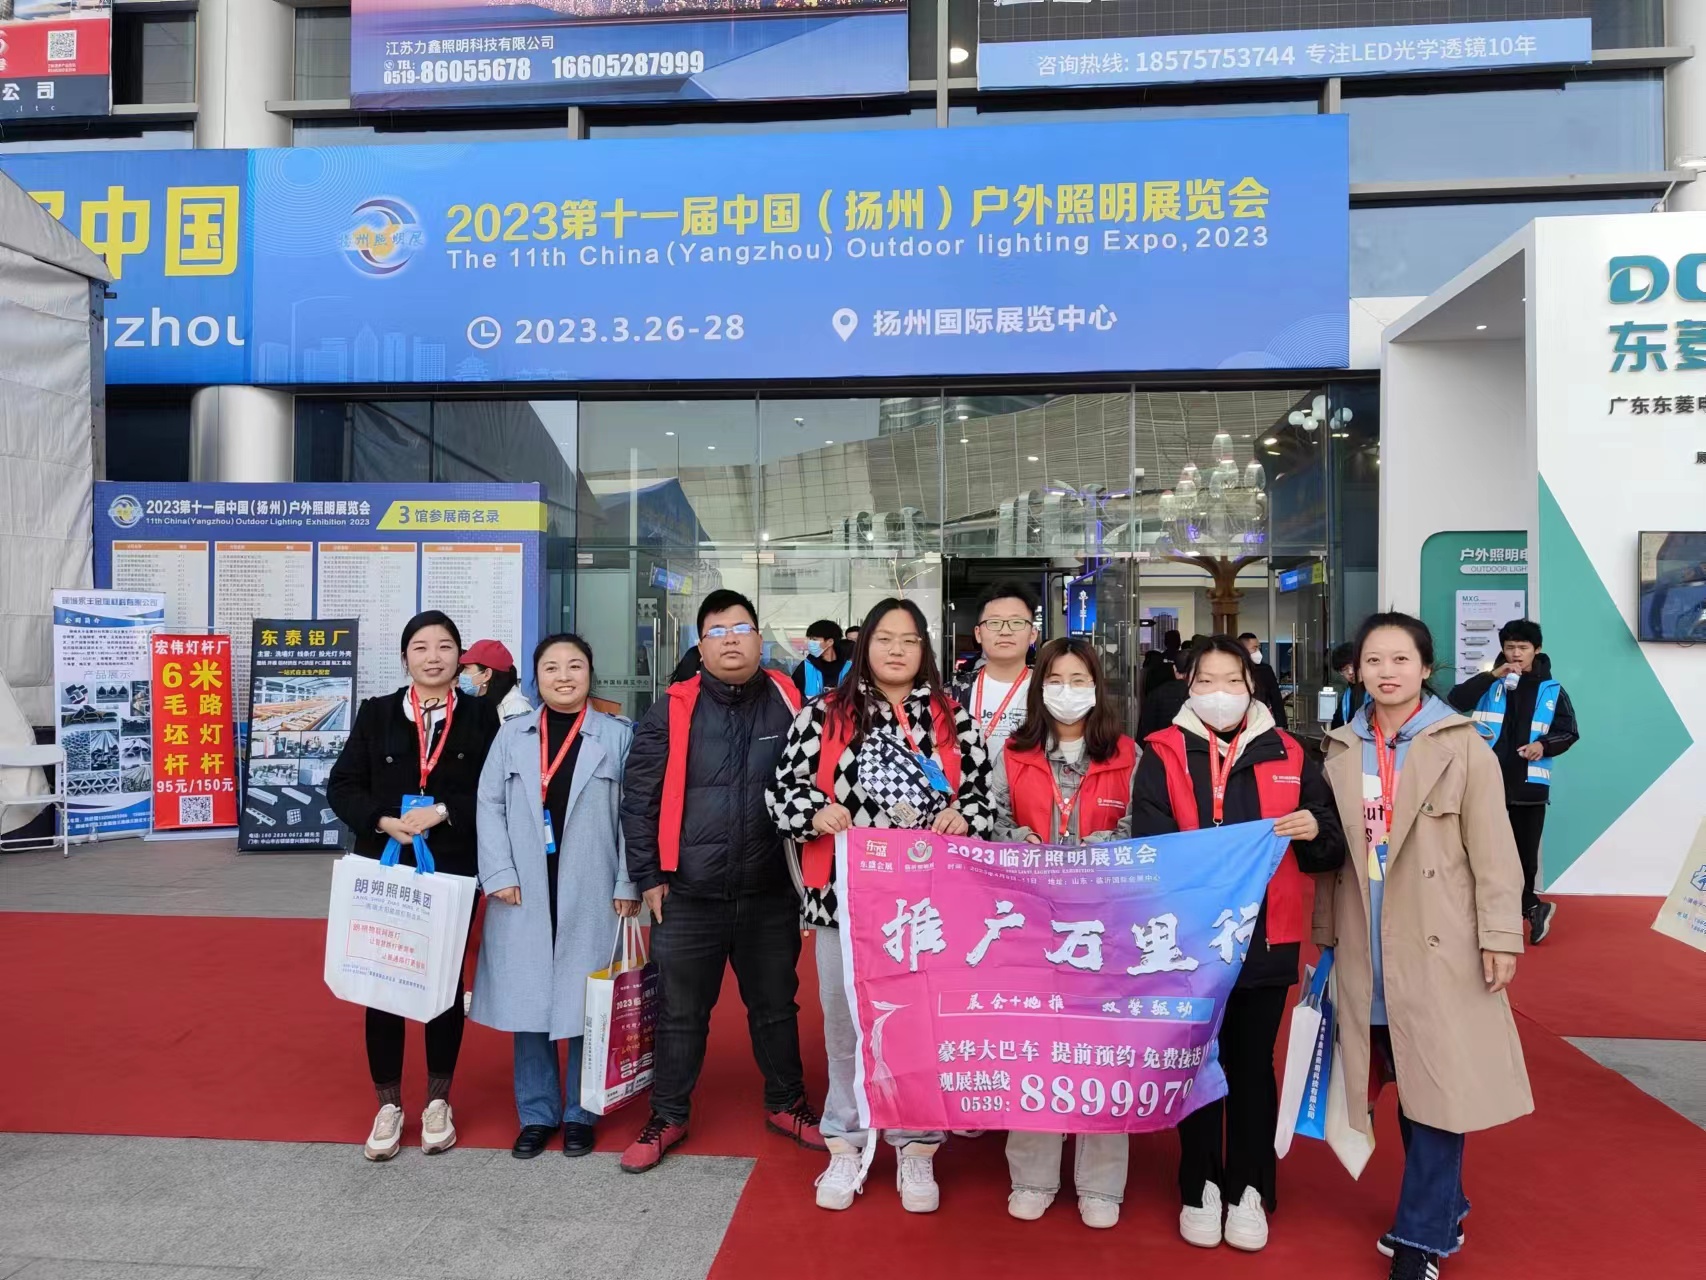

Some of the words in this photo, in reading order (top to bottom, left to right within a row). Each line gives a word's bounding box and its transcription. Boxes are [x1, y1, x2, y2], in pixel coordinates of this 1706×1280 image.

[386, 36, 554, 55] 江苏力鑫照明科技有限公司
[1136, 46, 1295, 72] 18575753744
[1306, 35, 1537, 64] 专注LED光学透镜10年
[552, 51, 704, 79] 16605287999
[28, 185, 240, 280] 中国
[447, 249, 497, 270] The
[510, 247, 567, 268] 11th
[847, 235, 964, 259] Outdoor
[978, 232, 1089, 257] lighting
[103, 307, 245, 350] zhou
[515, 314, 745, 344] 2023.3.26-28
[873, 303, 1118, 337] 扬州国际展览中心
[270, 518, 302, 527] Lighting
[415, 509, 500, 523] 馆参展商名录
[154, 639, 230, 655] 宏伟灯杆厂
[261, 629, 349, 646] 东泰铝厂
[84, 670, 131, 680] 产品展示
[981, 709, 1006, 721] Jep
[157, 778, 234, 793] 95元/150元
[1363, 804, 1385, 821] ut
[354, 878, 432, 909] 朗朔照明集团
[938, 1039, 1040, 1062] 豪华大巴车
[1051, 1041, 1136, 1067] 提前预约
[939, 1071, 1011, 1092] 观展热线
